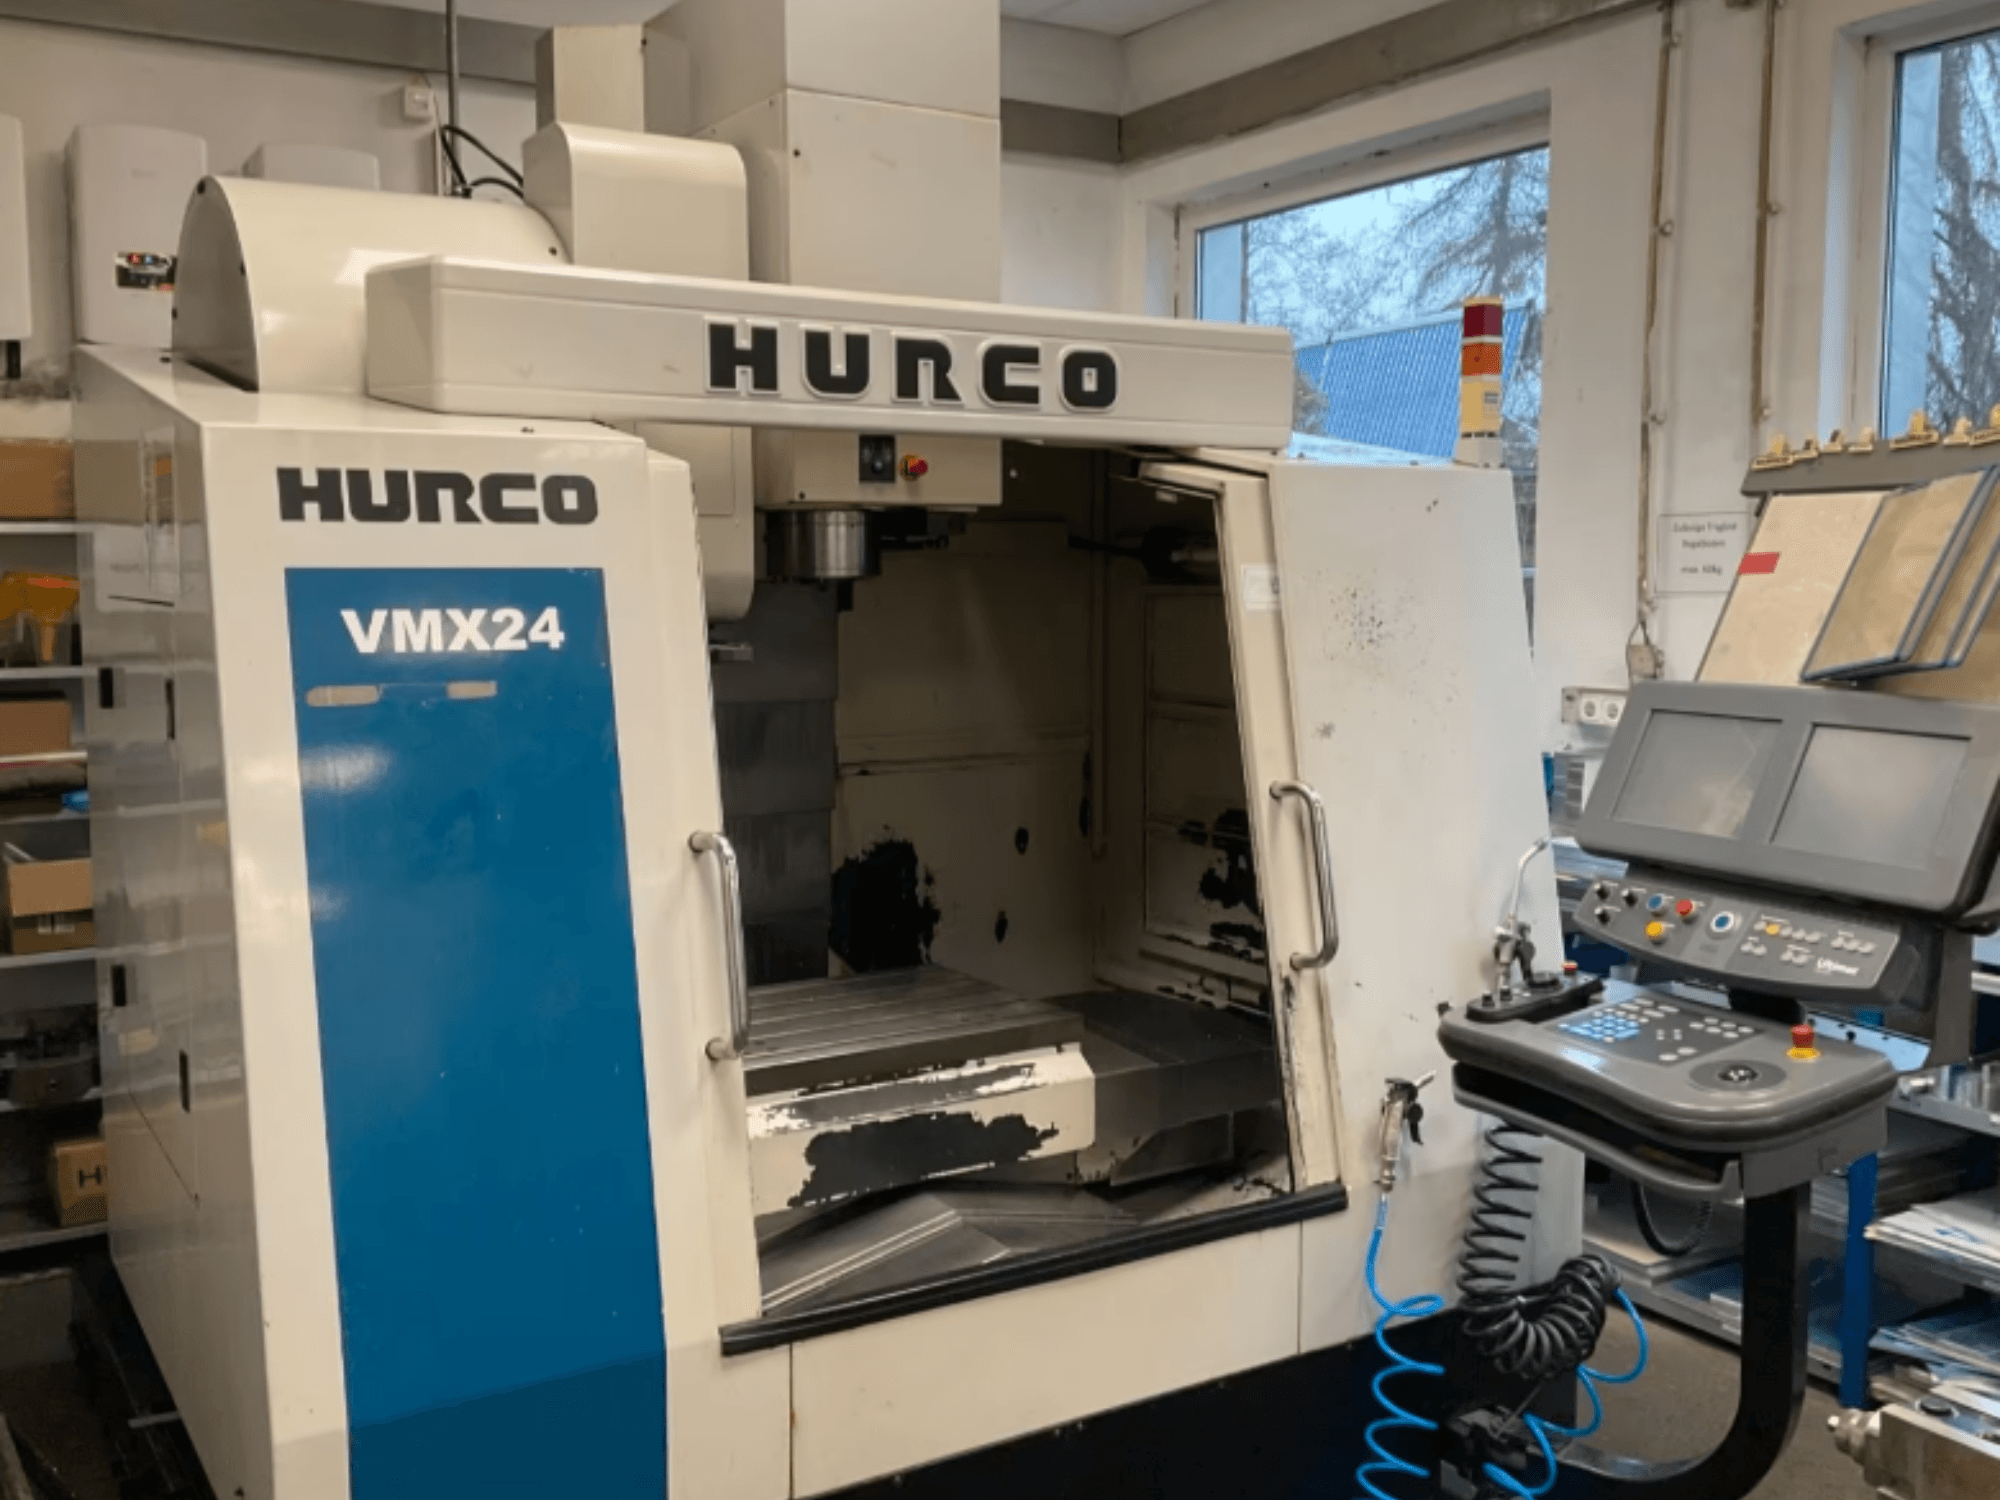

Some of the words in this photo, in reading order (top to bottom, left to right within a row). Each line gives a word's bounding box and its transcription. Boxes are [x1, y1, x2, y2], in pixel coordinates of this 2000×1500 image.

[707, 321, 1119, 411] HURCO
[276, 467, 598, 525] HURCO
[340, 606, 565, 653] VMX24
